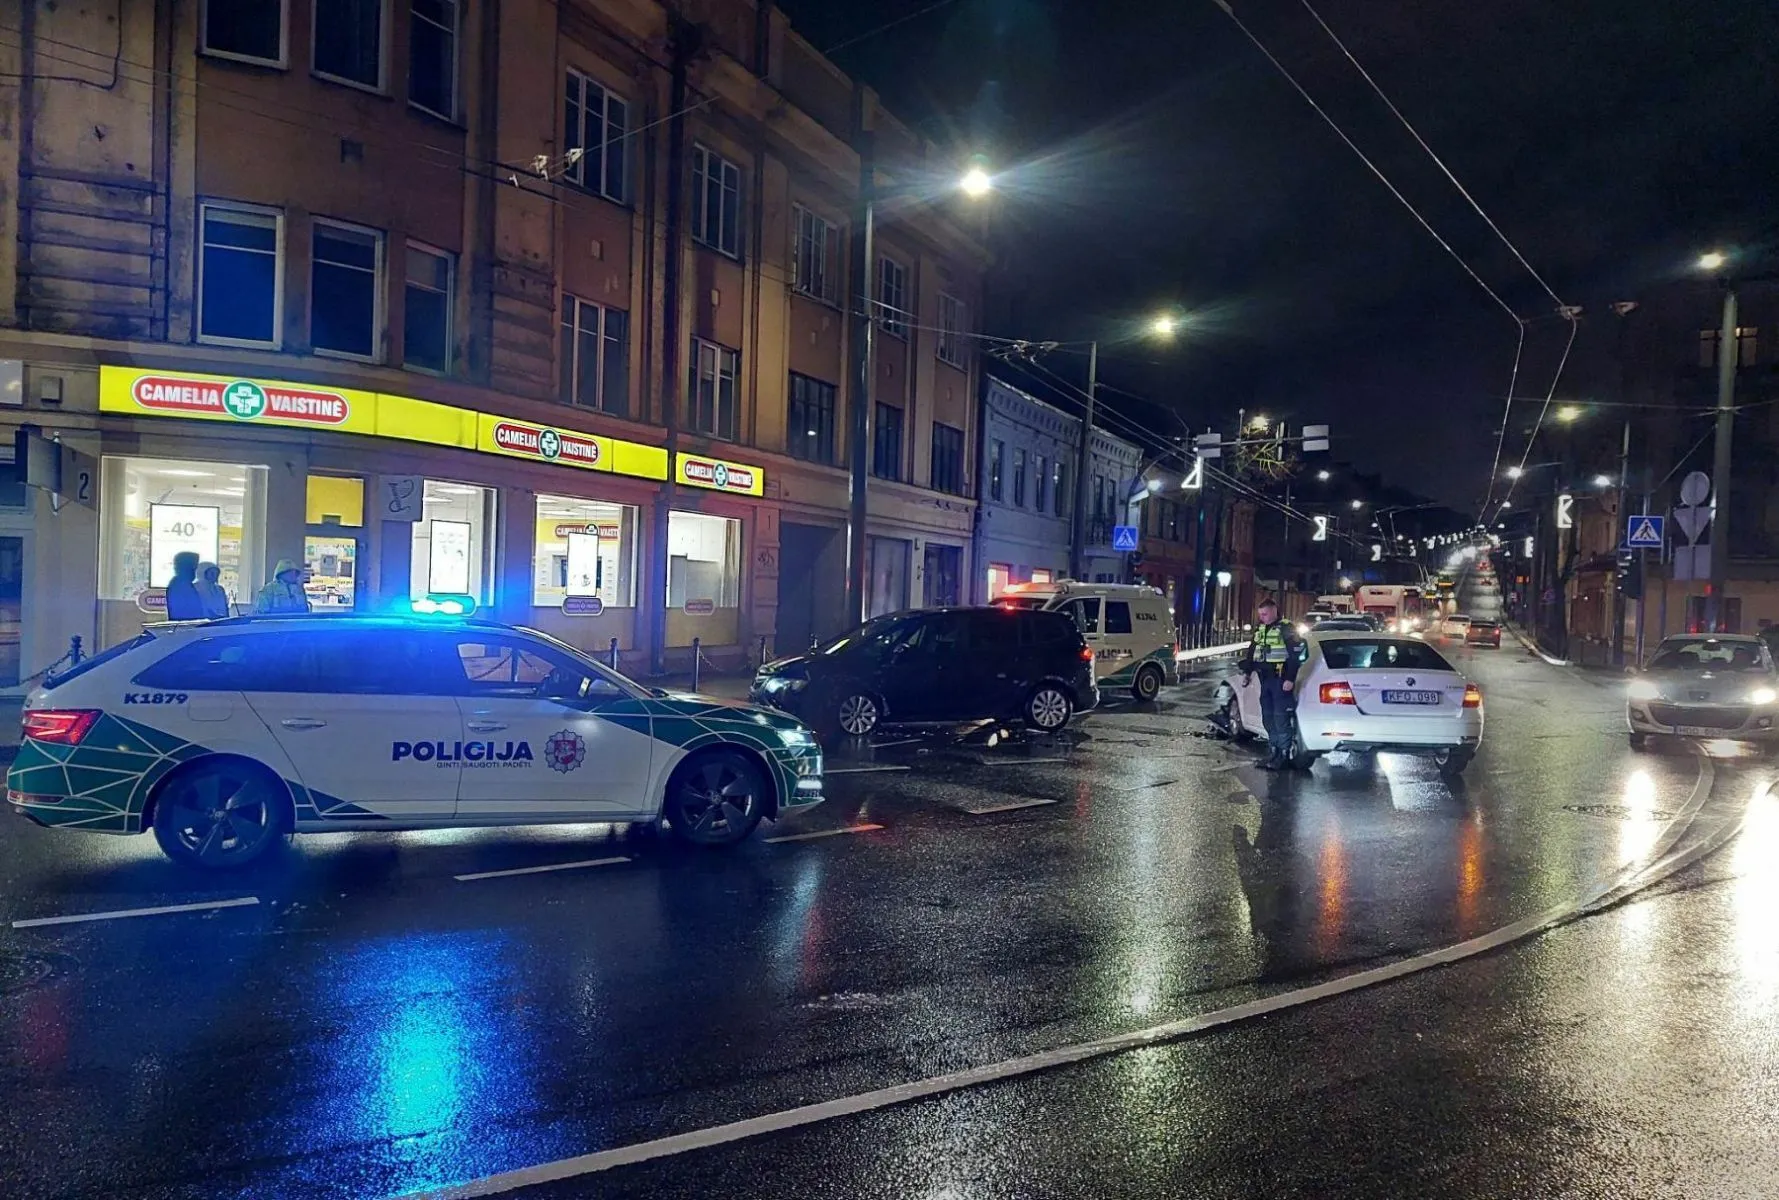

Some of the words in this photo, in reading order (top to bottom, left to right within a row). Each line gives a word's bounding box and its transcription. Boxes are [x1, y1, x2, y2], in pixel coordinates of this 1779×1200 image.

[140, 383, 220, 406] CAMELIA
[497, 428, 537, 448] CAMELIA
[1096, 648, 1134, 660] OLICIJA
[123, 692, 189, 705] K1879
[392, 741, 534, 761] POLICIJA
